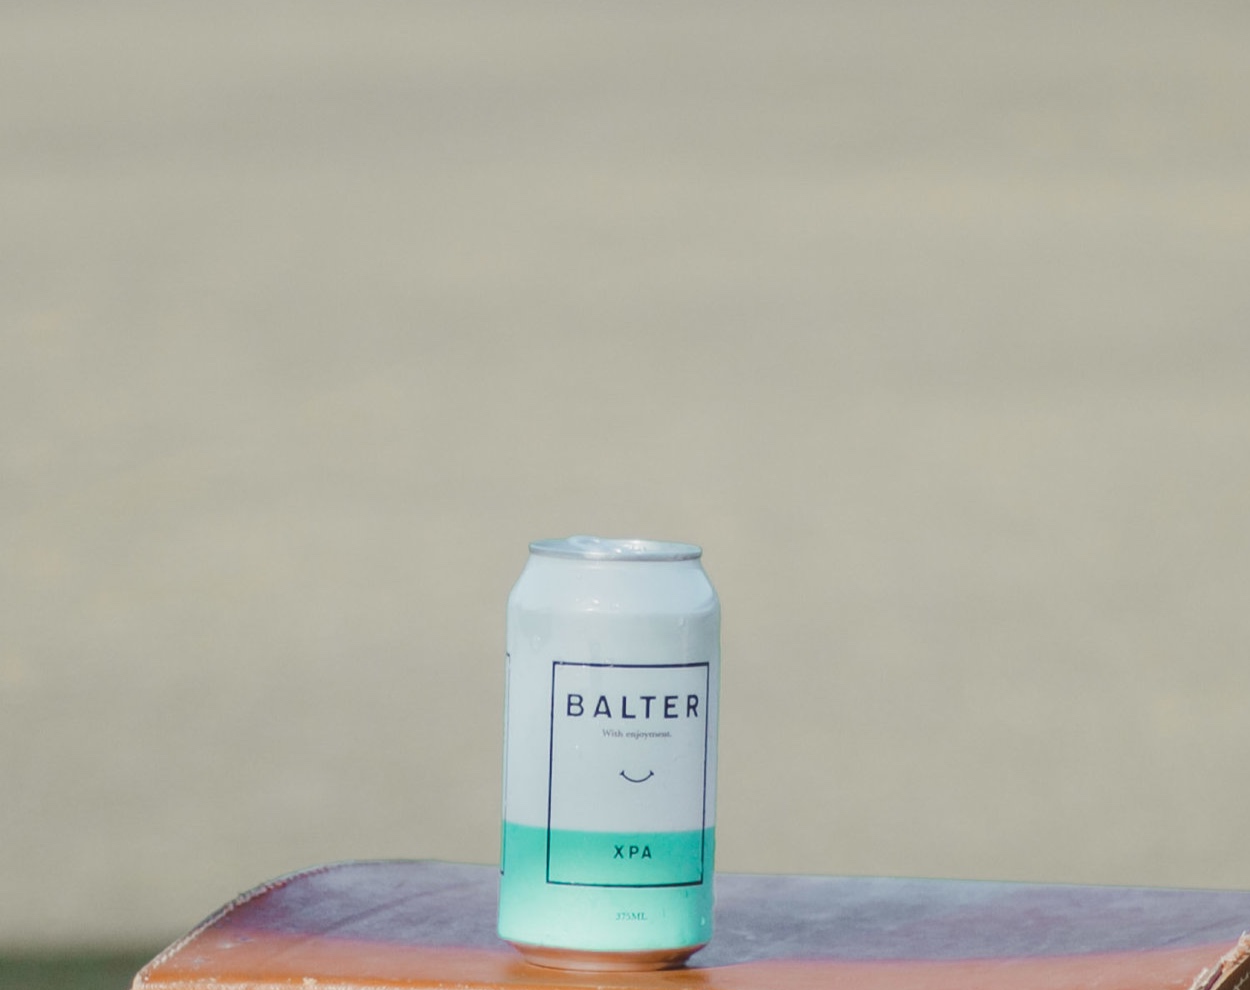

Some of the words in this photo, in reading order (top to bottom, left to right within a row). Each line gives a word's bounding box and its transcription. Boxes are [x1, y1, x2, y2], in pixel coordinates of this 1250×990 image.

[566, 693, 699, 719] BALTER
[602, 729, 623, 738] With
[613, 845, 652, 859] XPA
